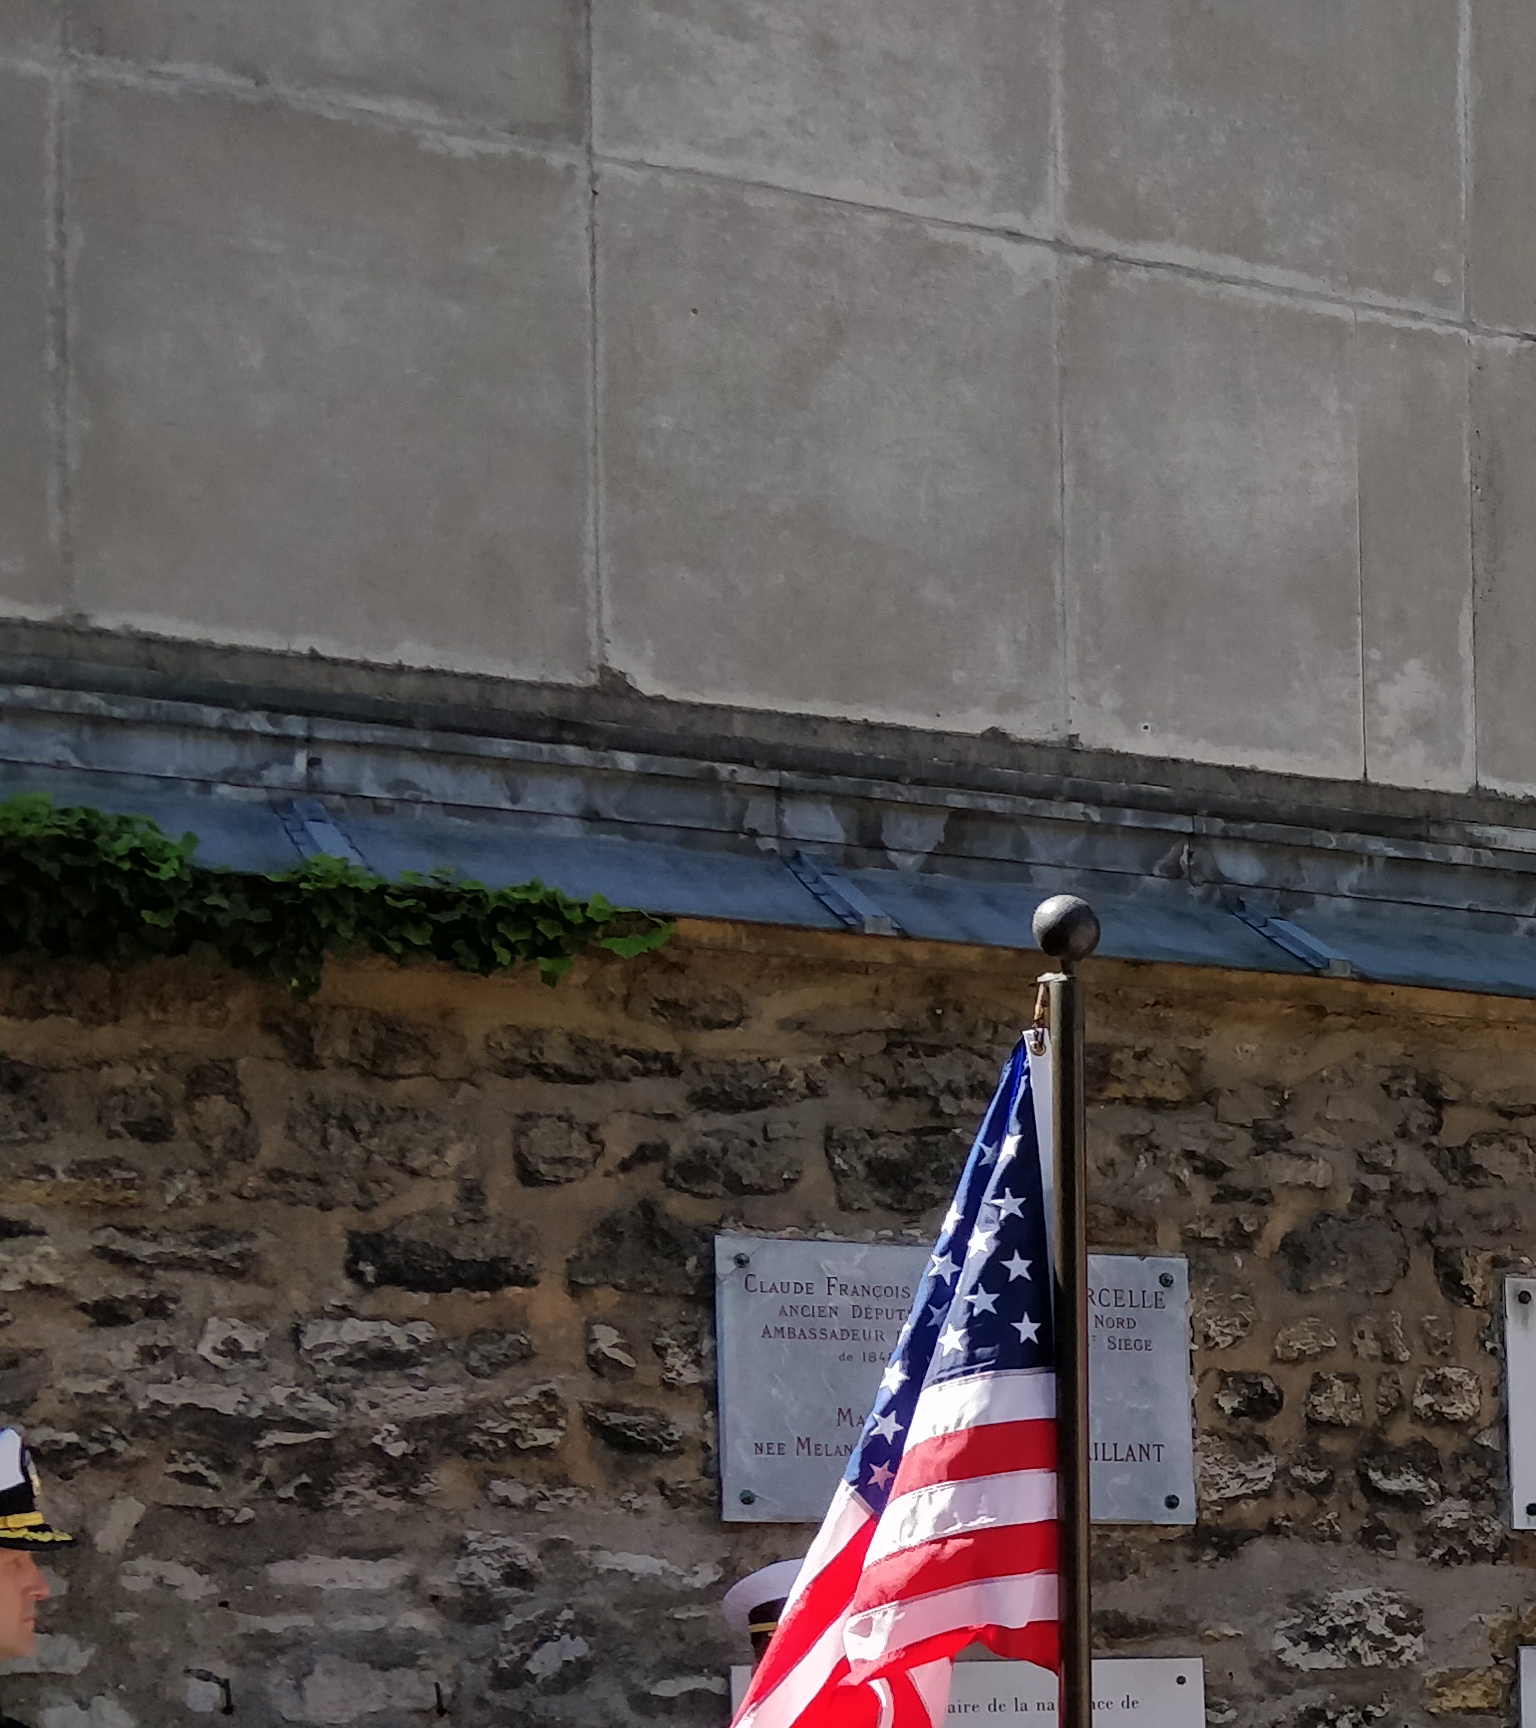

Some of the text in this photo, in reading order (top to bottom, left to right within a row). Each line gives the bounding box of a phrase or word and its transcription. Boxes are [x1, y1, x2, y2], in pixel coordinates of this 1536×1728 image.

[744, 1274, 1165, 1309] CLAUDE FRANÇOIS RCELLE
[779, 1304, 1136, 1329] ANCIEN DÉPUT NORD
[761, 1325, 886, 1342] AMBASSADEUR
[838, 1352, 853, 1361] de
[796, 1436, 853, 1457] MELAN
[948, 1700, 980, 1714] aire
[988, 1698, 1006, 1713] de
[1014, 1697, 1028, 1712] la
[1121, 1695, 1139, 1709] de
